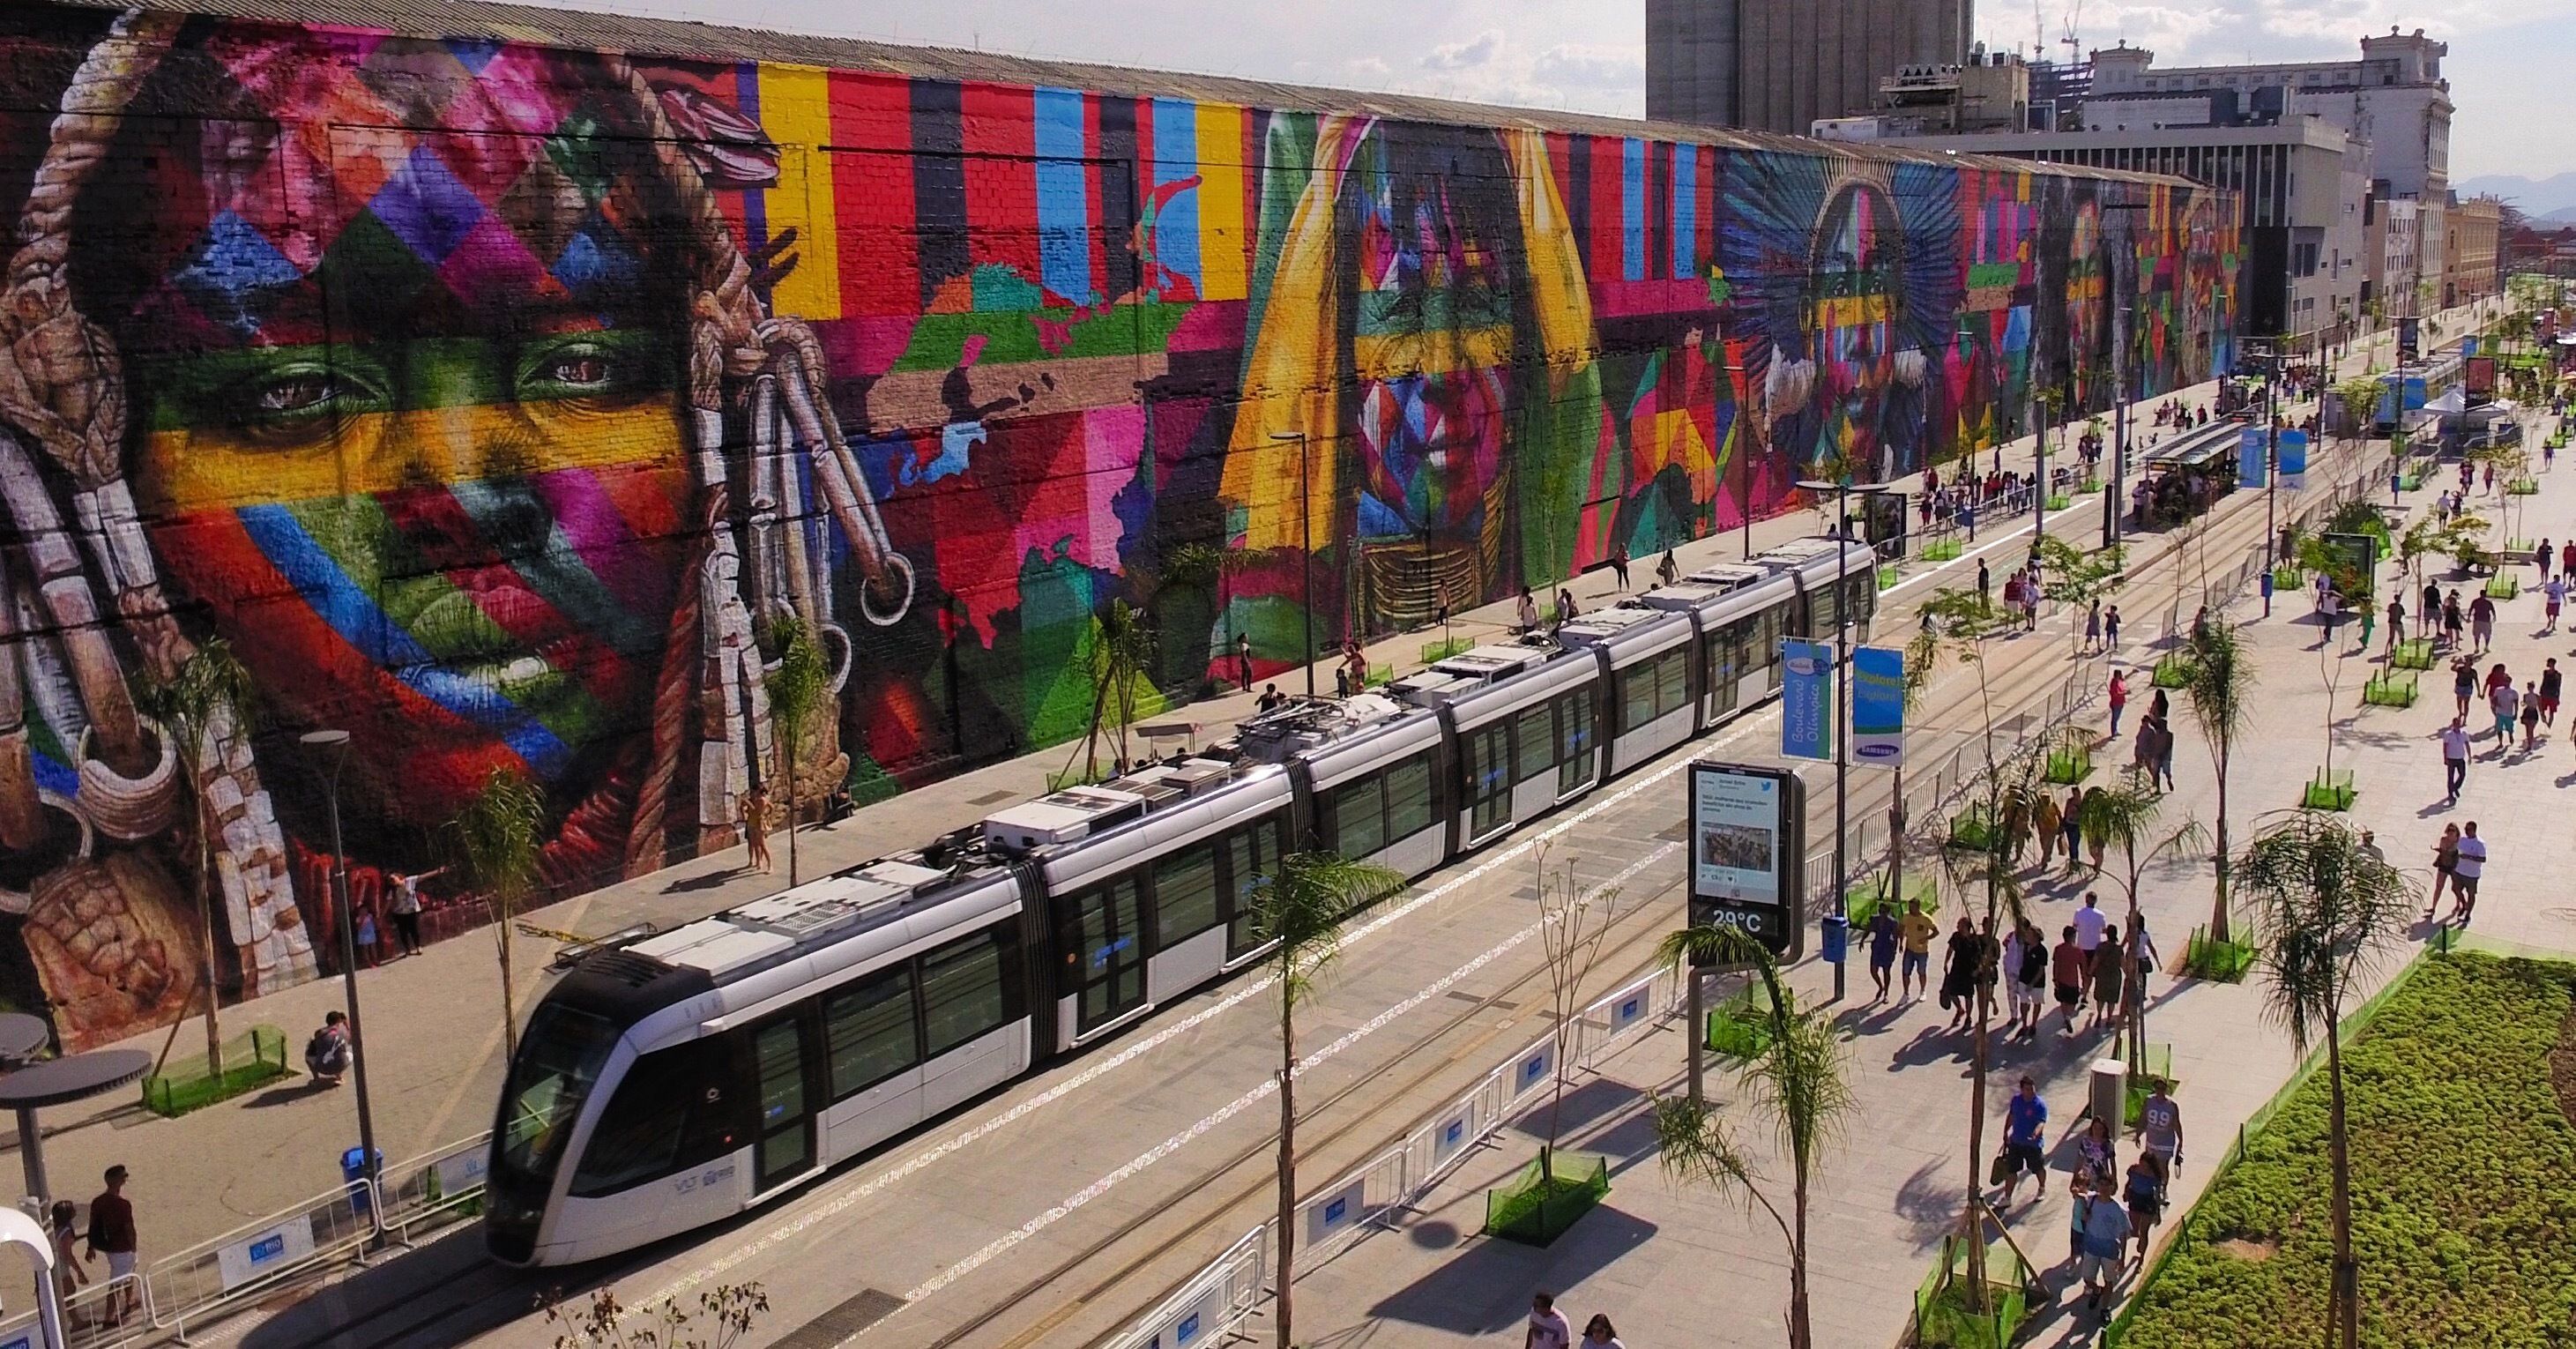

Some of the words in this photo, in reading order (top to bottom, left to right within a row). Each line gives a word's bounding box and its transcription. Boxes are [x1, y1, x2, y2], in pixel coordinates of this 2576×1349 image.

[1791, 679, 1805, 742] Boulevard
[1860, 745, 1895, 756] SAMSUNG
[1713, 909, 1761, 933] 29°C
[2148, 1109, 2170, 1127] 99
